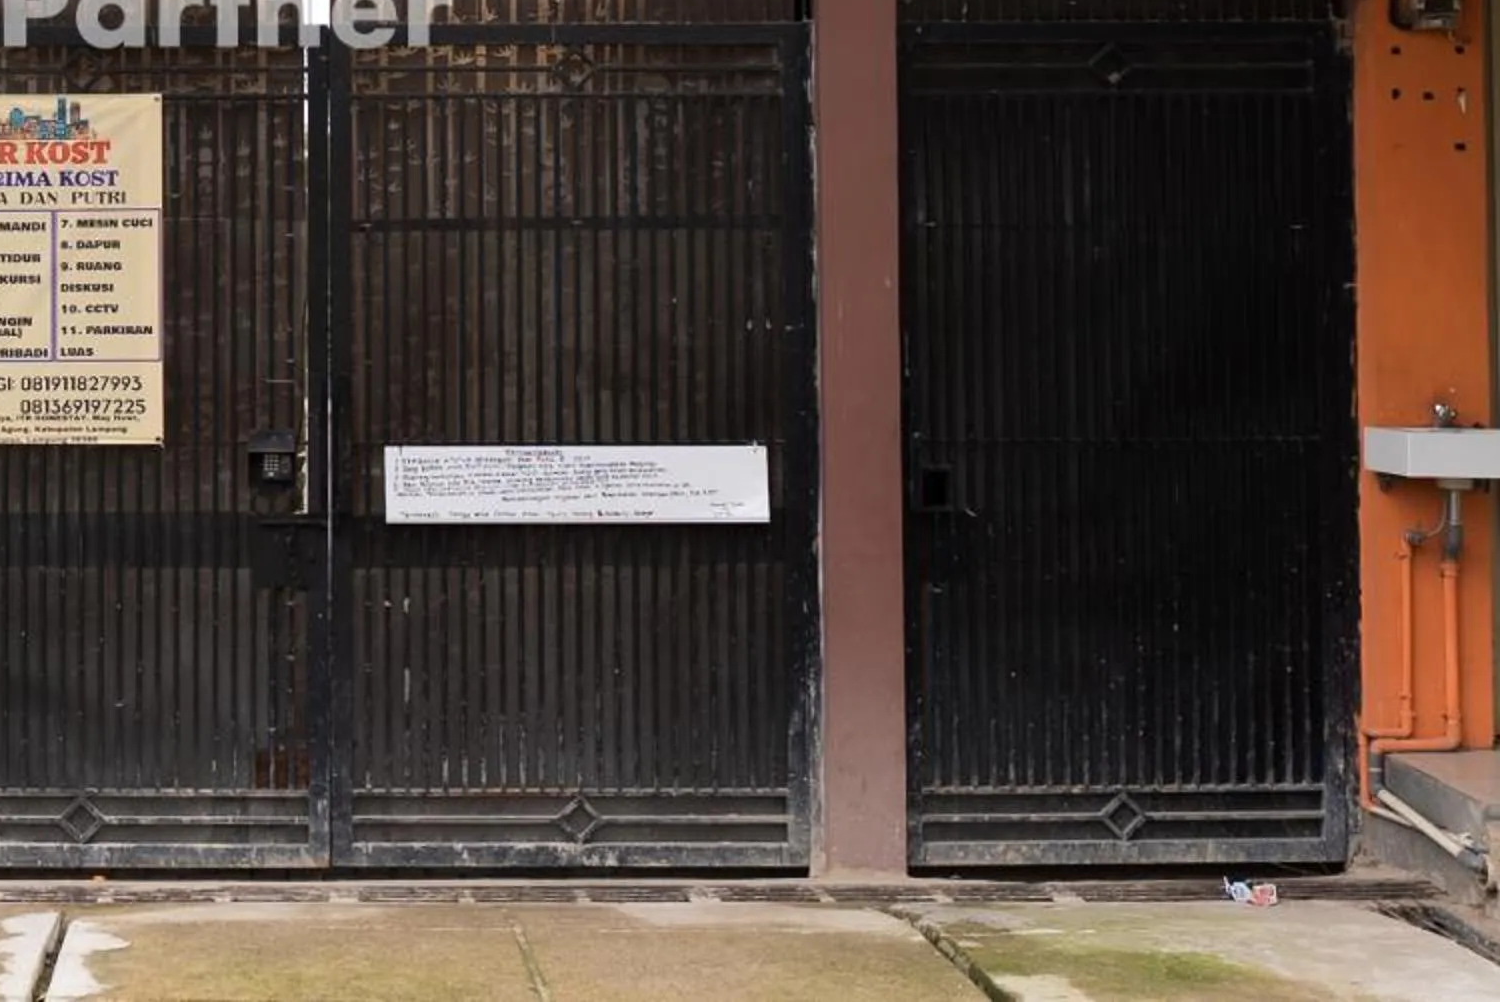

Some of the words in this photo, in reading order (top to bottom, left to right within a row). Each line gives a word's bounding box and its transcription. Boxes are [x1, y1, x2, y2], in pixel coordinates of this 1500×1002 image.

[25, 141, 110, 164] KOST
[59, 170, 119, 187] KOST
[20, 193, 58, 205] DAN
[72, 192, 125, 205] PUTRI
[61, 220, 72, 228] 7.
[76, 220, 118, 228] MESIN
[123, 219, 153, 227] CUCI
[76, 241, 120, 249] DAPUR
[0, 254, 40, 263] TIDUR
[76, 262, 122, 271] RUANG
[0, 275, 40, 284] KURSI
[61, 284, 114, 293] DISKUSI
[61, 305, 82, 313] 10.
[86, 305, 119, 313] CCTV
[61, 326, 82, 335] 11.
[86, 326, 153, 335] PARKIRAN
[61, 348, 94, 356] LUAS
[21, 376, 142, 391] 081911827993
[20, 400, 146, 414] 081369197225
